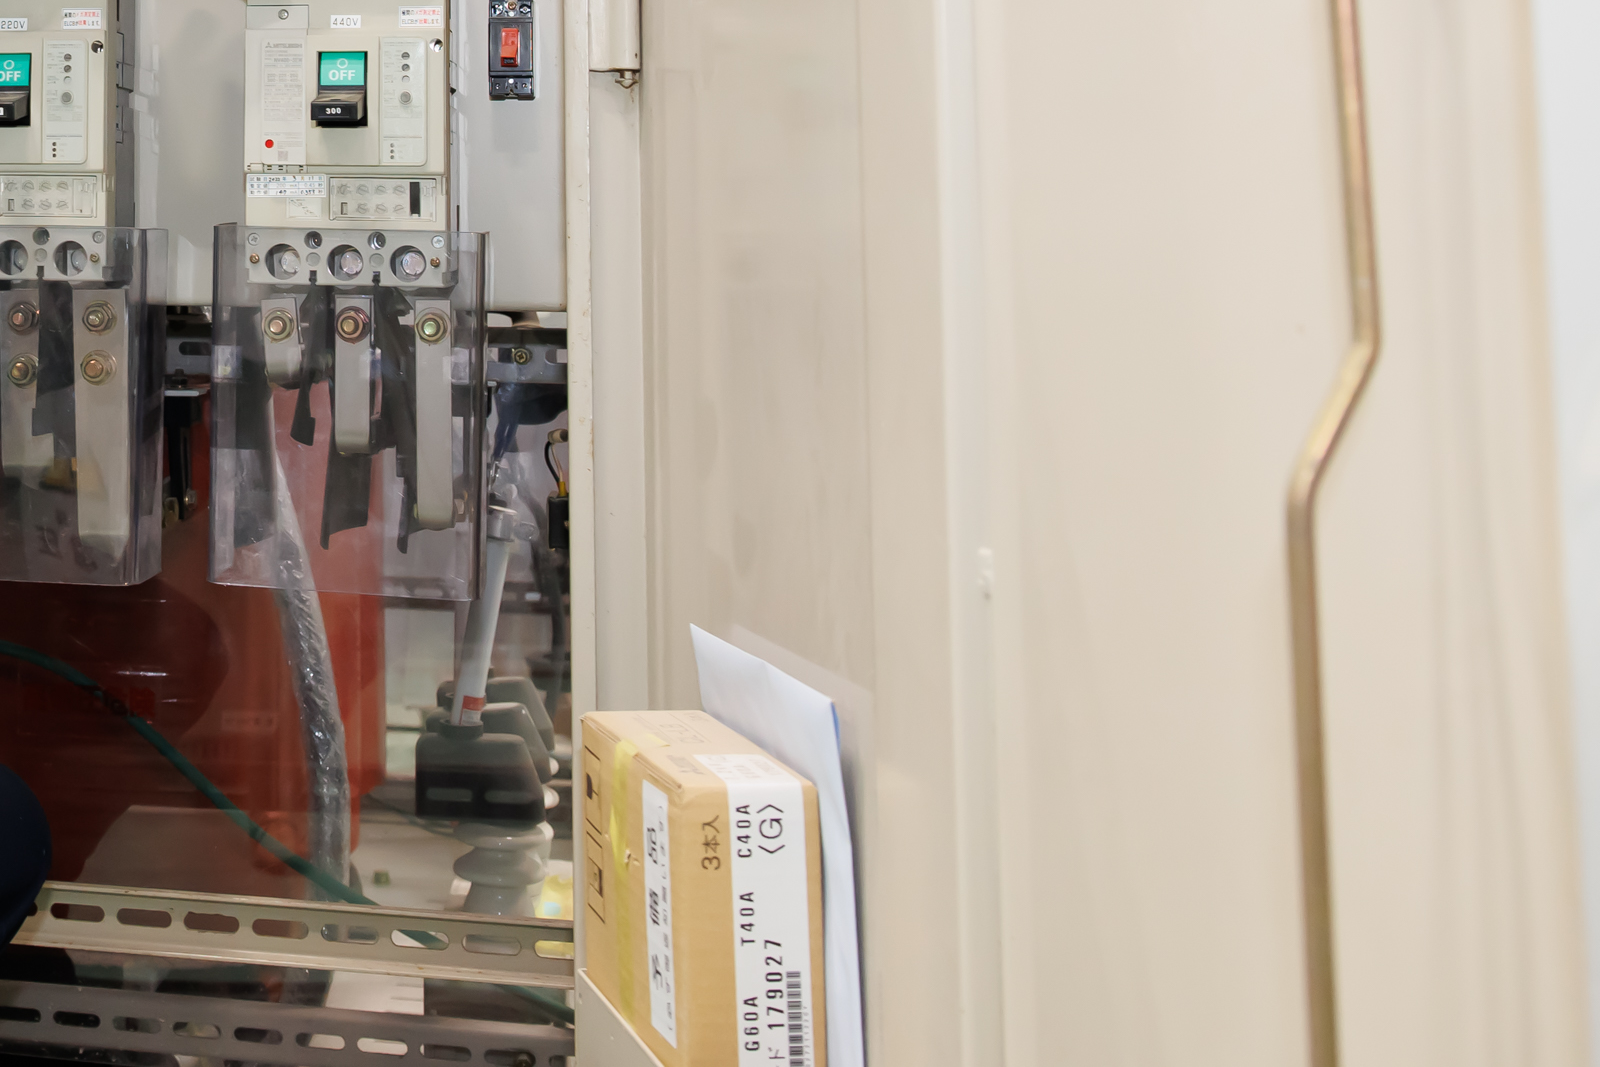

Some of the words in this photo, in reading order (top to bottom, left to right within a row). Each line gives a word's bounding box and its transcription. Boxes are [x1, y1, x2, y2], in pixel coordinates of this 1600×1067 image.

[0, 20, 26, 30] 220V
[332, 17, 359, 27] 440V
[328, 69, 356, 81] OFF
[325, 107, 342, 115] 300
[702, 814, 721, 871] 3本入
[736, 804, 753, 858] C40A
[740, 891, 756, 946] T40A
[763, 939, 786, 1030] 179027
[743, 996, 761, 1052] G60A
